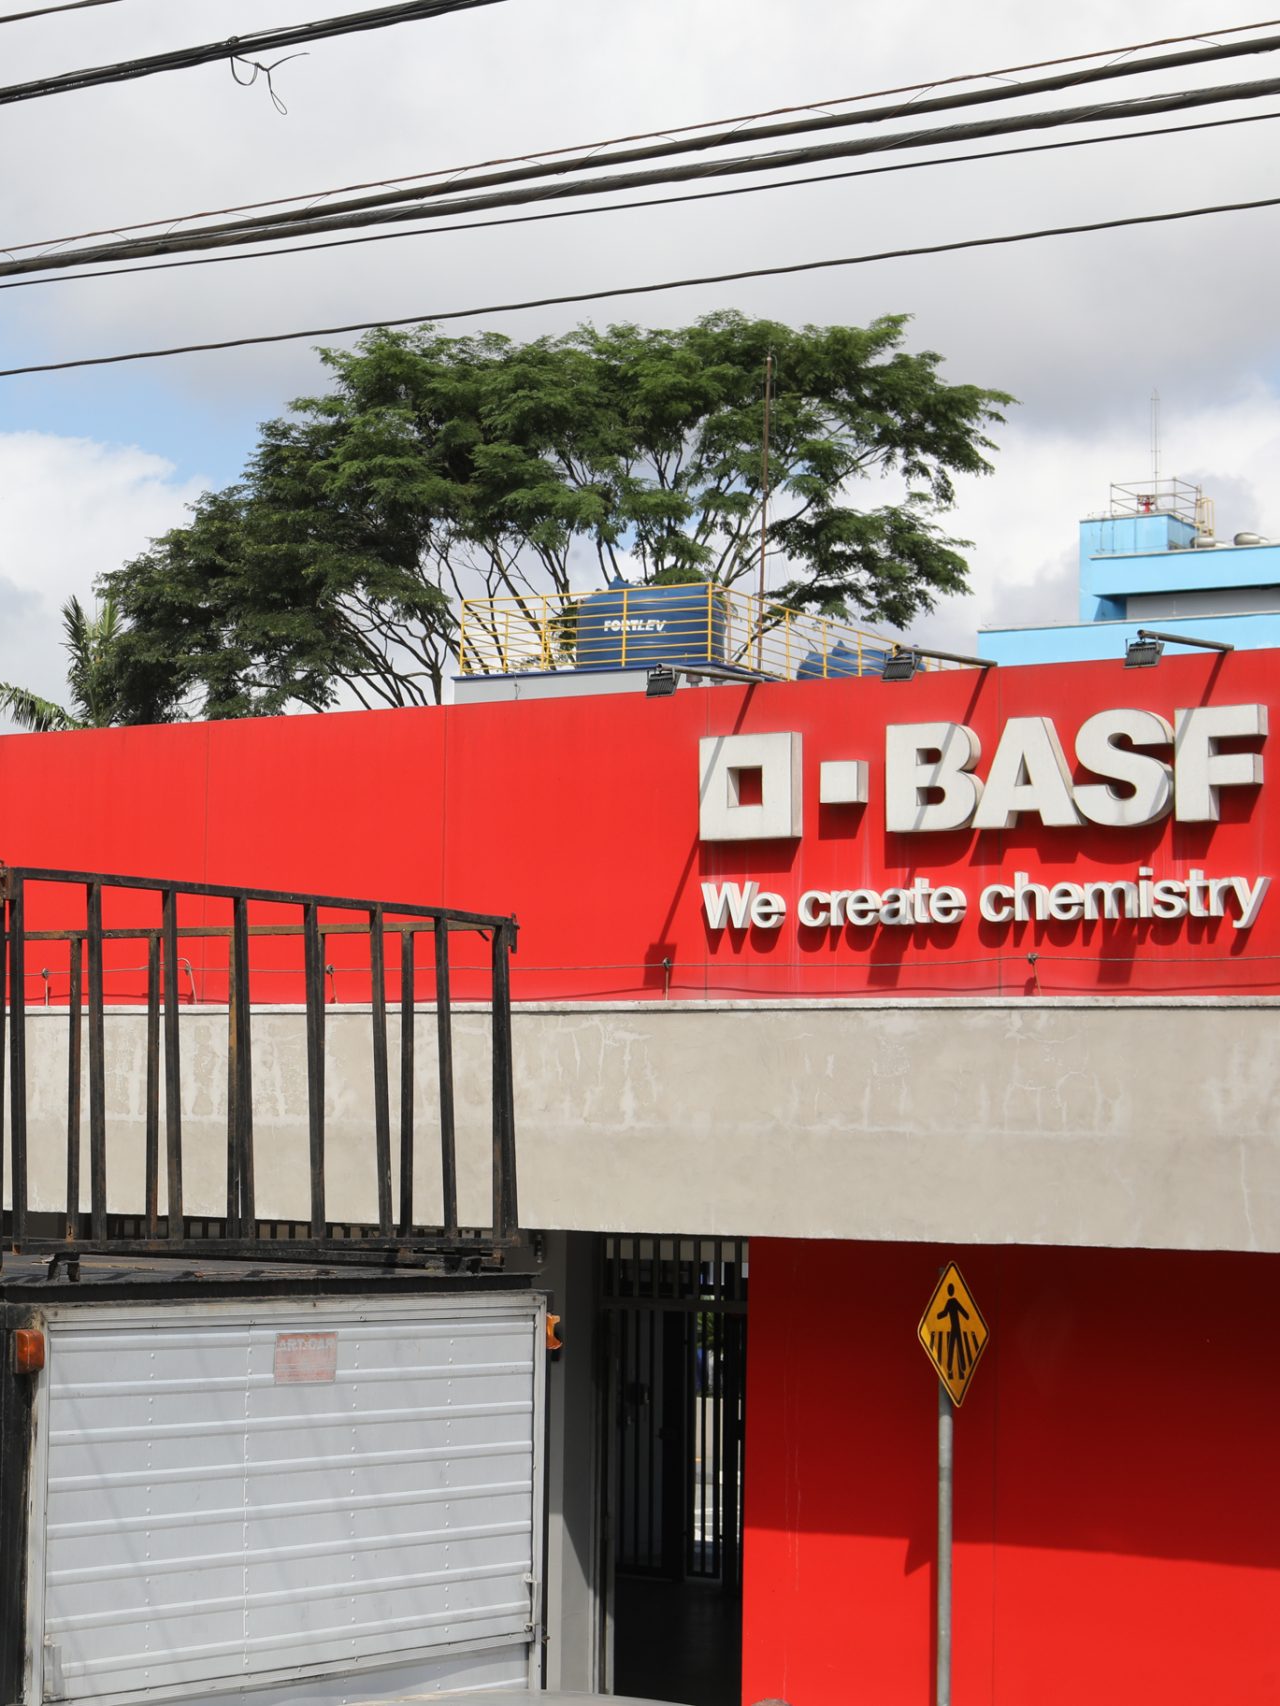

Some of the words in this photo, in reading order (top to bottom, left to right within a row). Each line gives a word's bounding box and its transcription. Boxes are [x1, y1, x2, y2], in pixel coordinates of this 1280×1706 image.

[604, 619, 667, 631] FORTLEV
[885, 704, 1268, 832] BASF
[701, 881, 785, 929] We
[797, 877, 966, 926] create
[979, 866, 1271, 929] chemistry
